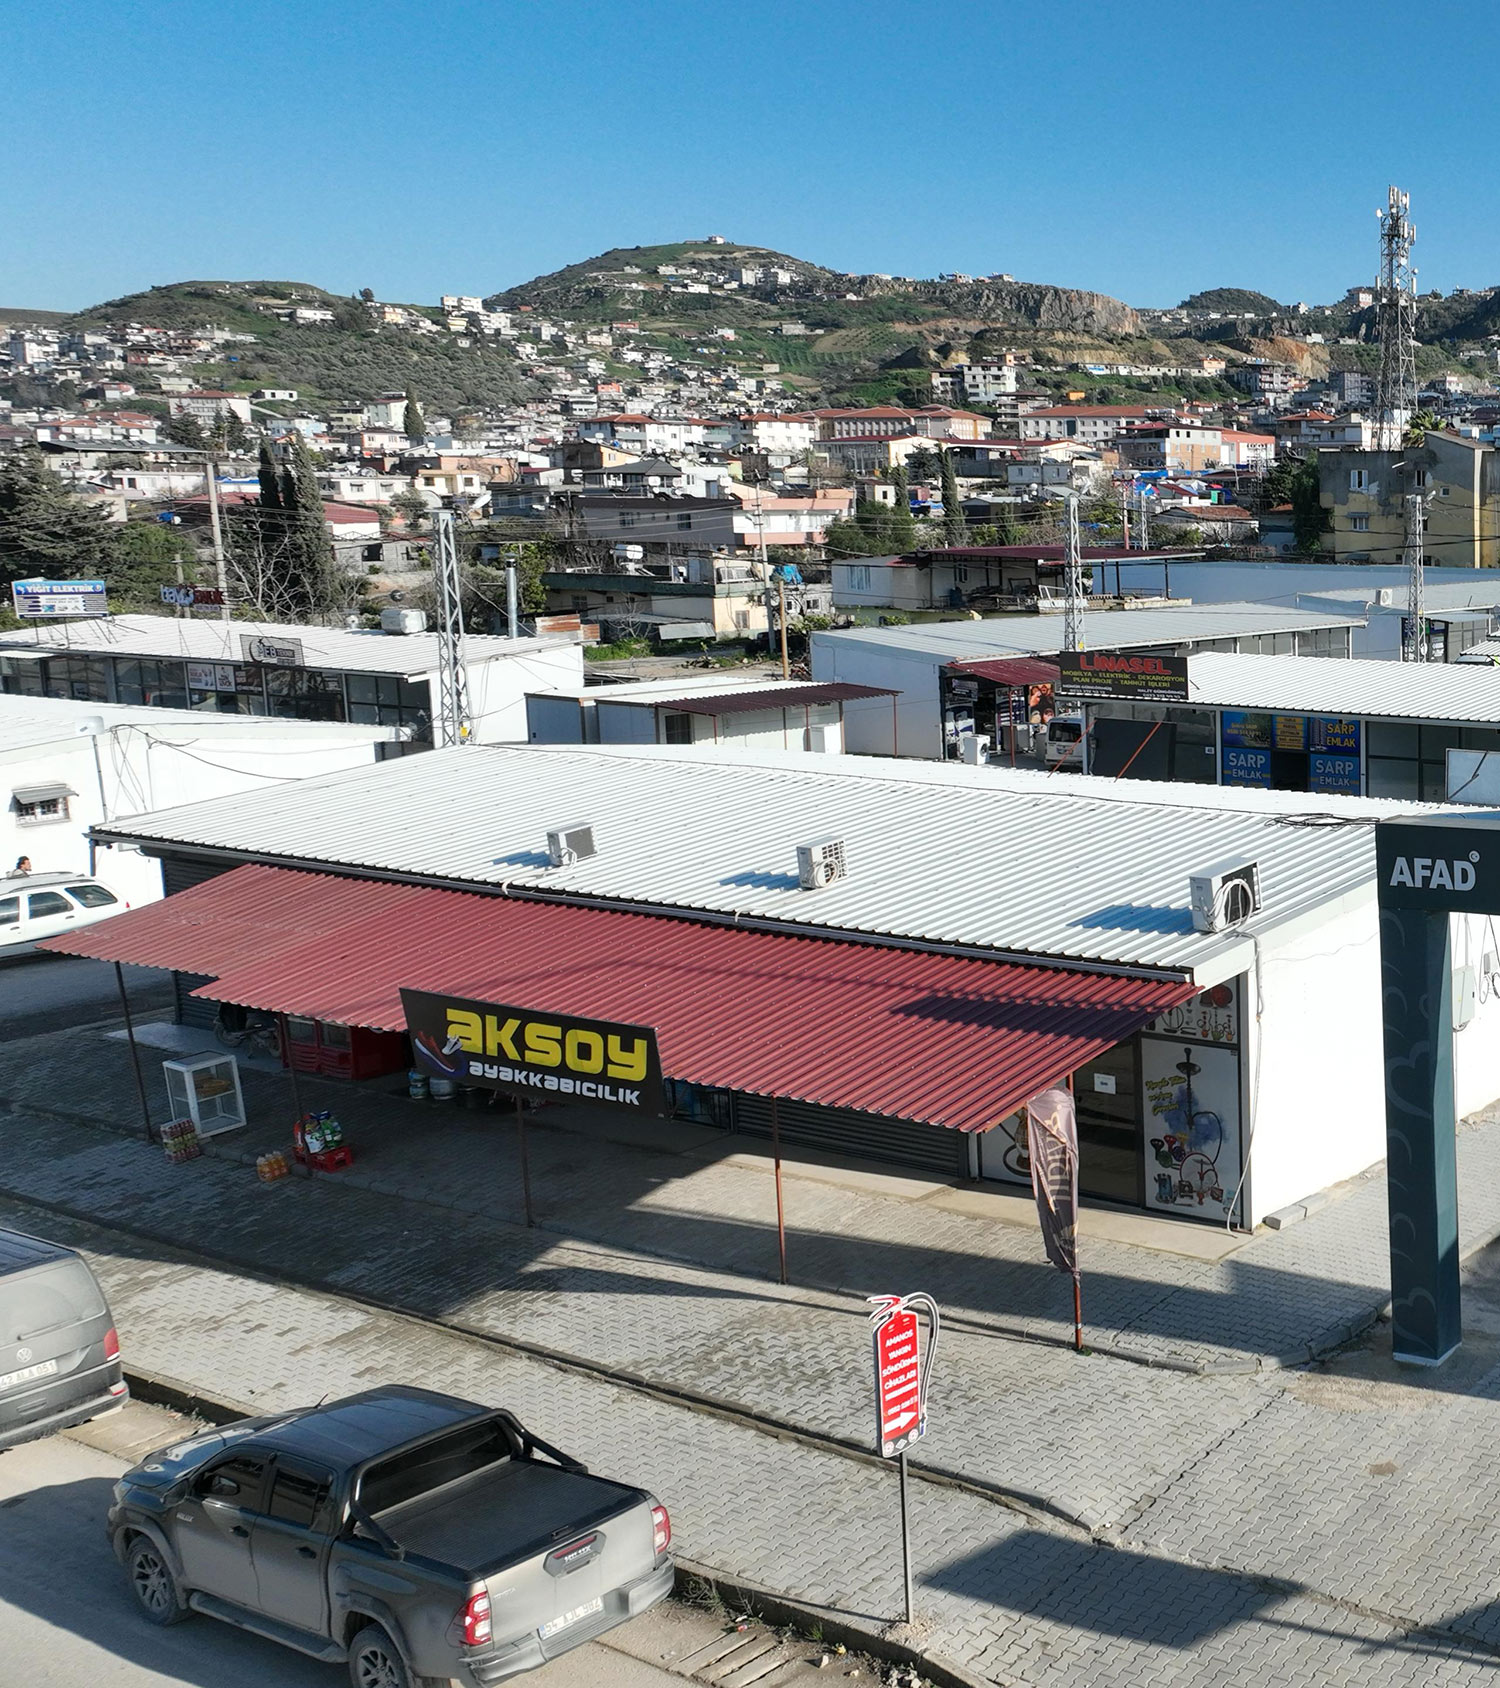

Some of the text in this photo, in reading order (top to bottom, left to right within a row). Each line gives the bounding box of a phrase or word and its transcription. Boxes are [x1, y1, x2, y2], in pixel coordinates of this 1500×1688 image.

[52, 584, 94, 593] ELEKTRİK
[1080, 652, 1172, 675] LİNASEL
[1099, 671, 1131, 679] ELEKTRİK
[1327, 722, 1355, 735] SARP
[1326, 737, 1356, 748] EMLAK
[1229, 752, 1266, 768] SARP
[1315, 760, 1354, 775] SARP
[1232, 768, 1262, 779] EMLAK
[1320, 776, 1350, 787] EMLAK
[1389, 857, 1476, 892] AFAD
[885, 1329, 914, 1347] AMANOS
[888, 1344, 912, 1360] YANGIN
[882, 1354, 918, 1377] SÖNDÜRME
[884, 1369, 917, 1390] CİHAZLARI
